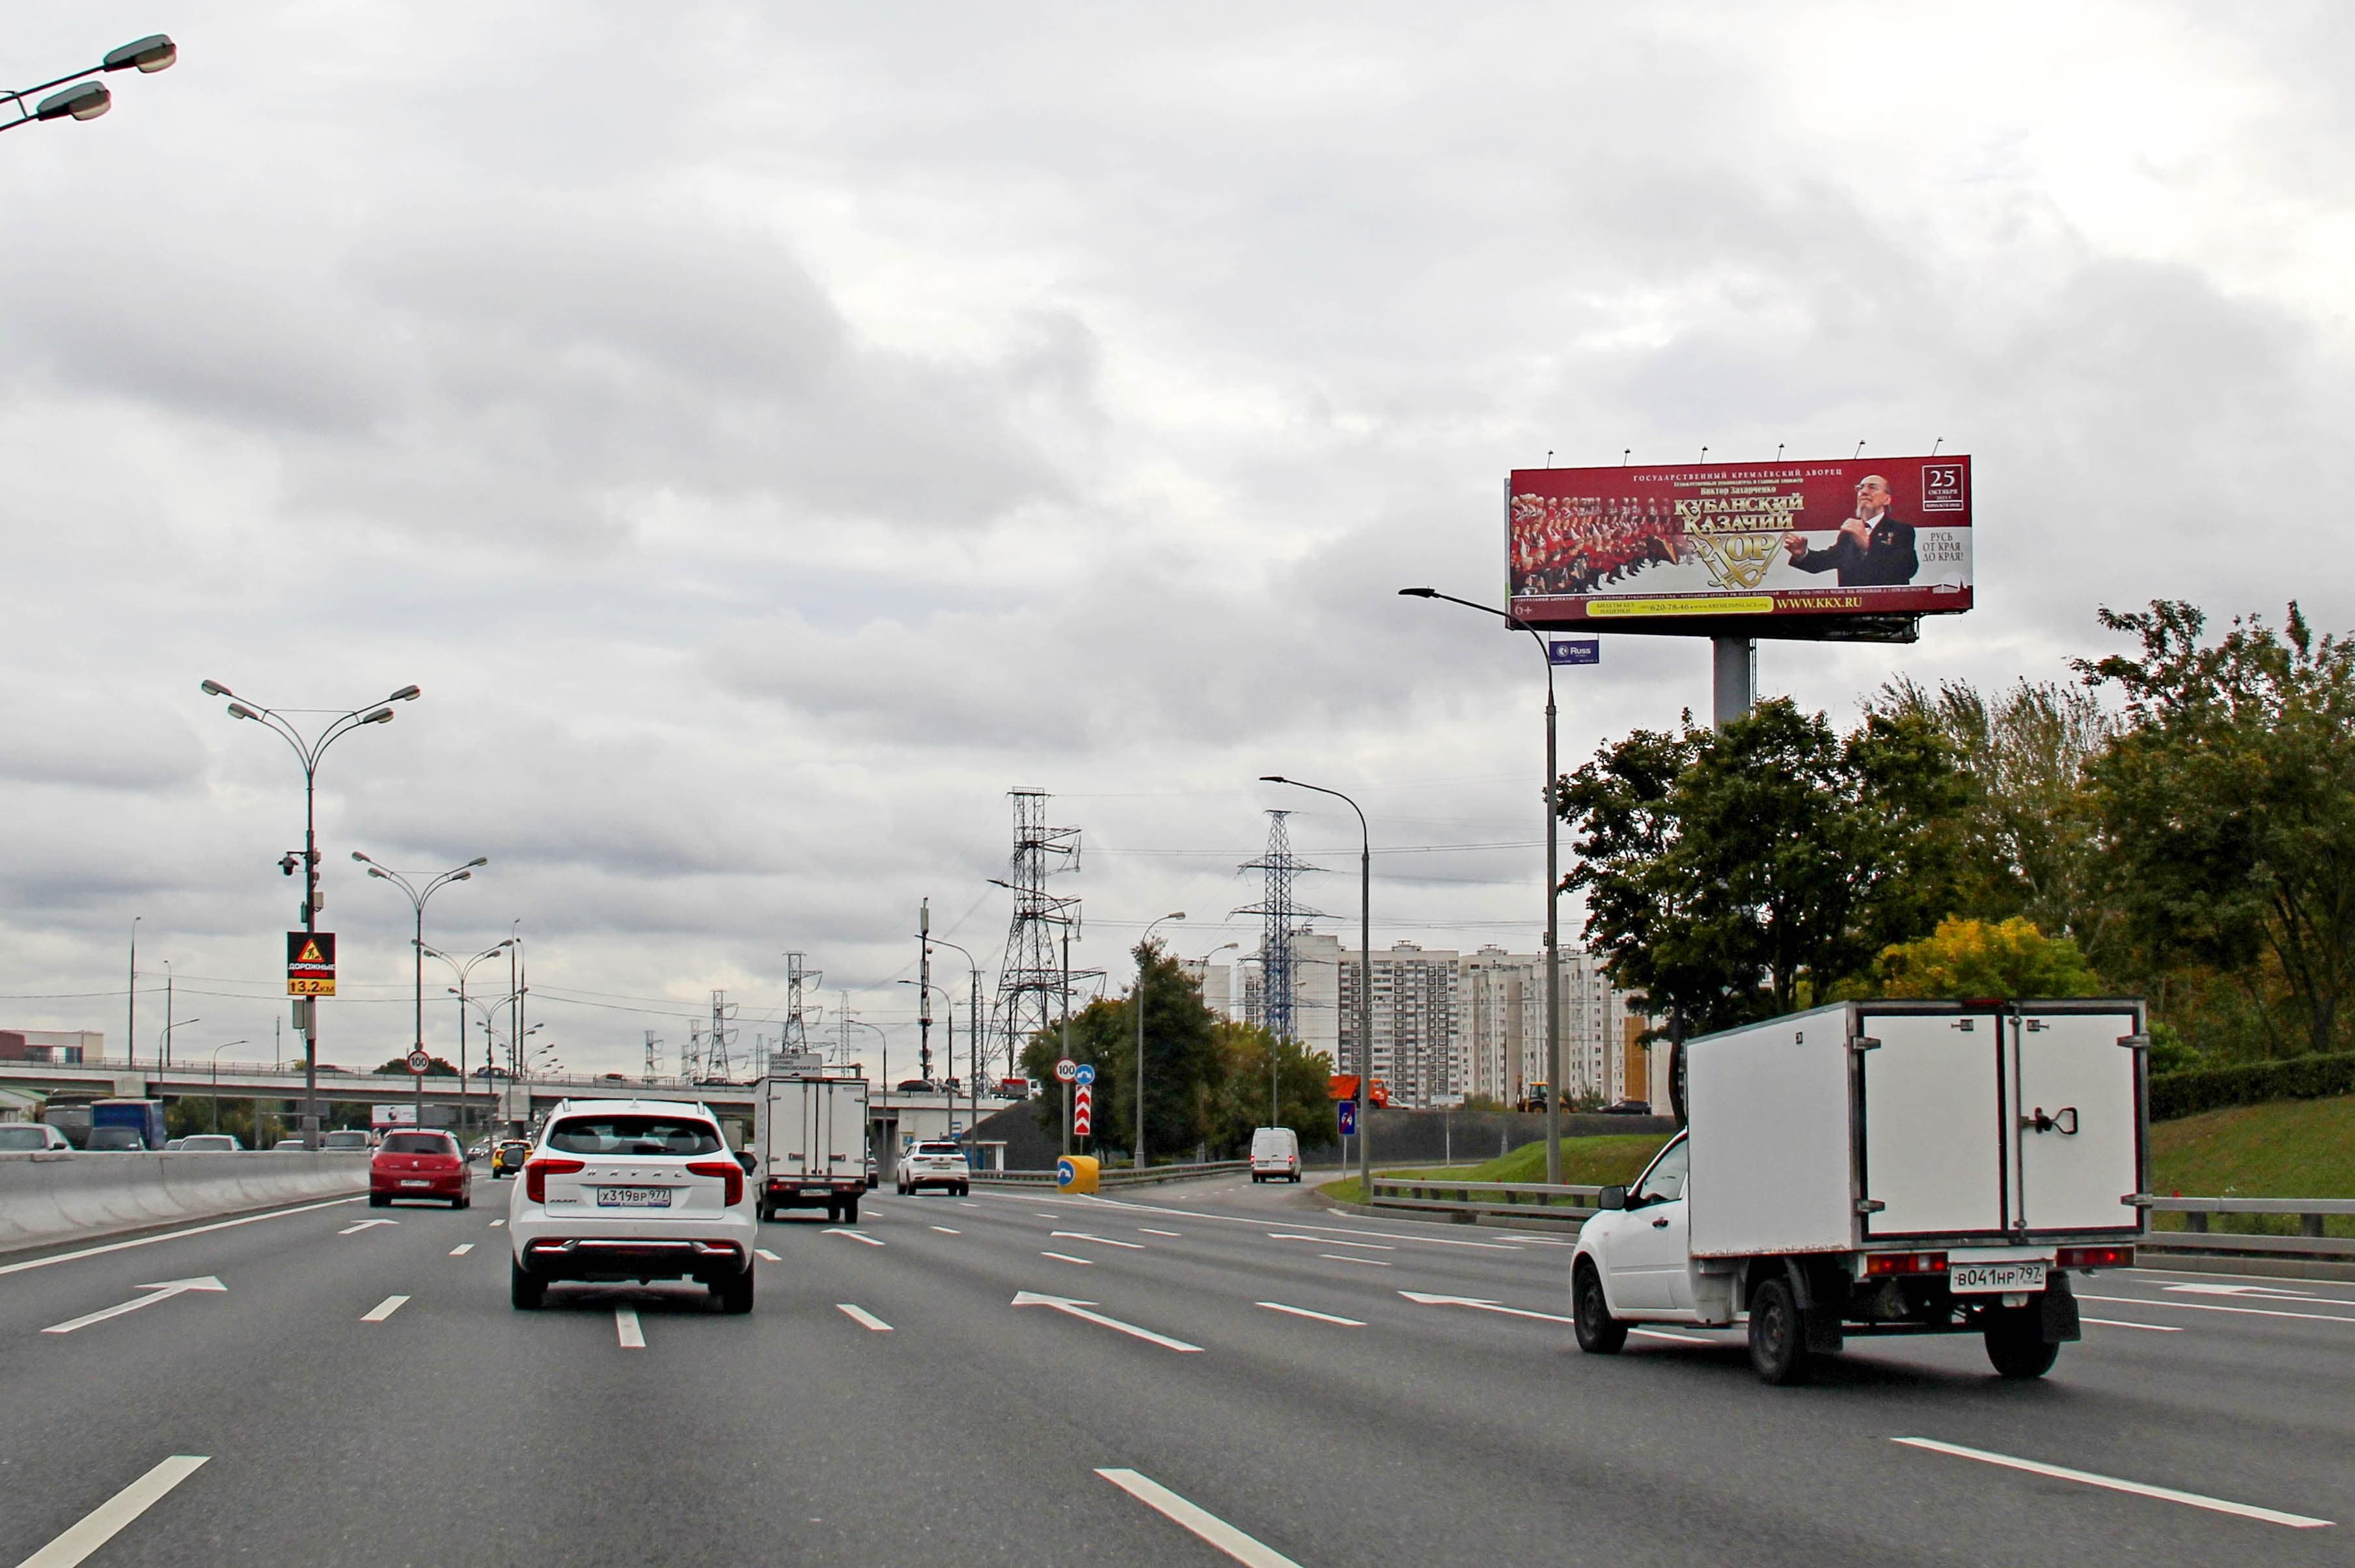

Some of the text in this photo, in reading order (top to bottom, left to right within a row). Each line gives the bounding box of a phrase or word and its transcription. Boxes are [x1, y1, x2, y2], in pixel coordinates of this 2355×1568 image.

[1633, 471, 1727, 482] ГОСУДАРСТВЕННЫЙ
[1805, 468, 1842, 476] ДВОРЕЦ
[1930, 469, 1955, 487] 25
[1700, 486, 1776, 495] Виктор Захарченко
[1673, 493, 1804, 517] КУБАНСКИЙ
[1683, 510, 1794, 535] КАЗАЧИЙ
[1931, 532, 1953, 542] РУСЬ
[1922, 542, 1961, 552] ОТ КРАЯ
[1922, 551, 1964, 562] ДО КРАЯ!
[1776, 597, 1862, 609] WWW.KKX.RU
[1514, 603, 1532, 616] 6+
[291, 980, 320, 992] 13.2
[411, 1057, 427, 1067] 100
[1058, 1065, 1075, 1075] 100
[586, 1168, 683, 1177] HAVAL
[649, 1190, 667, 1199] 977
[1958, 1267, 2041, 1286] В041НР 797
